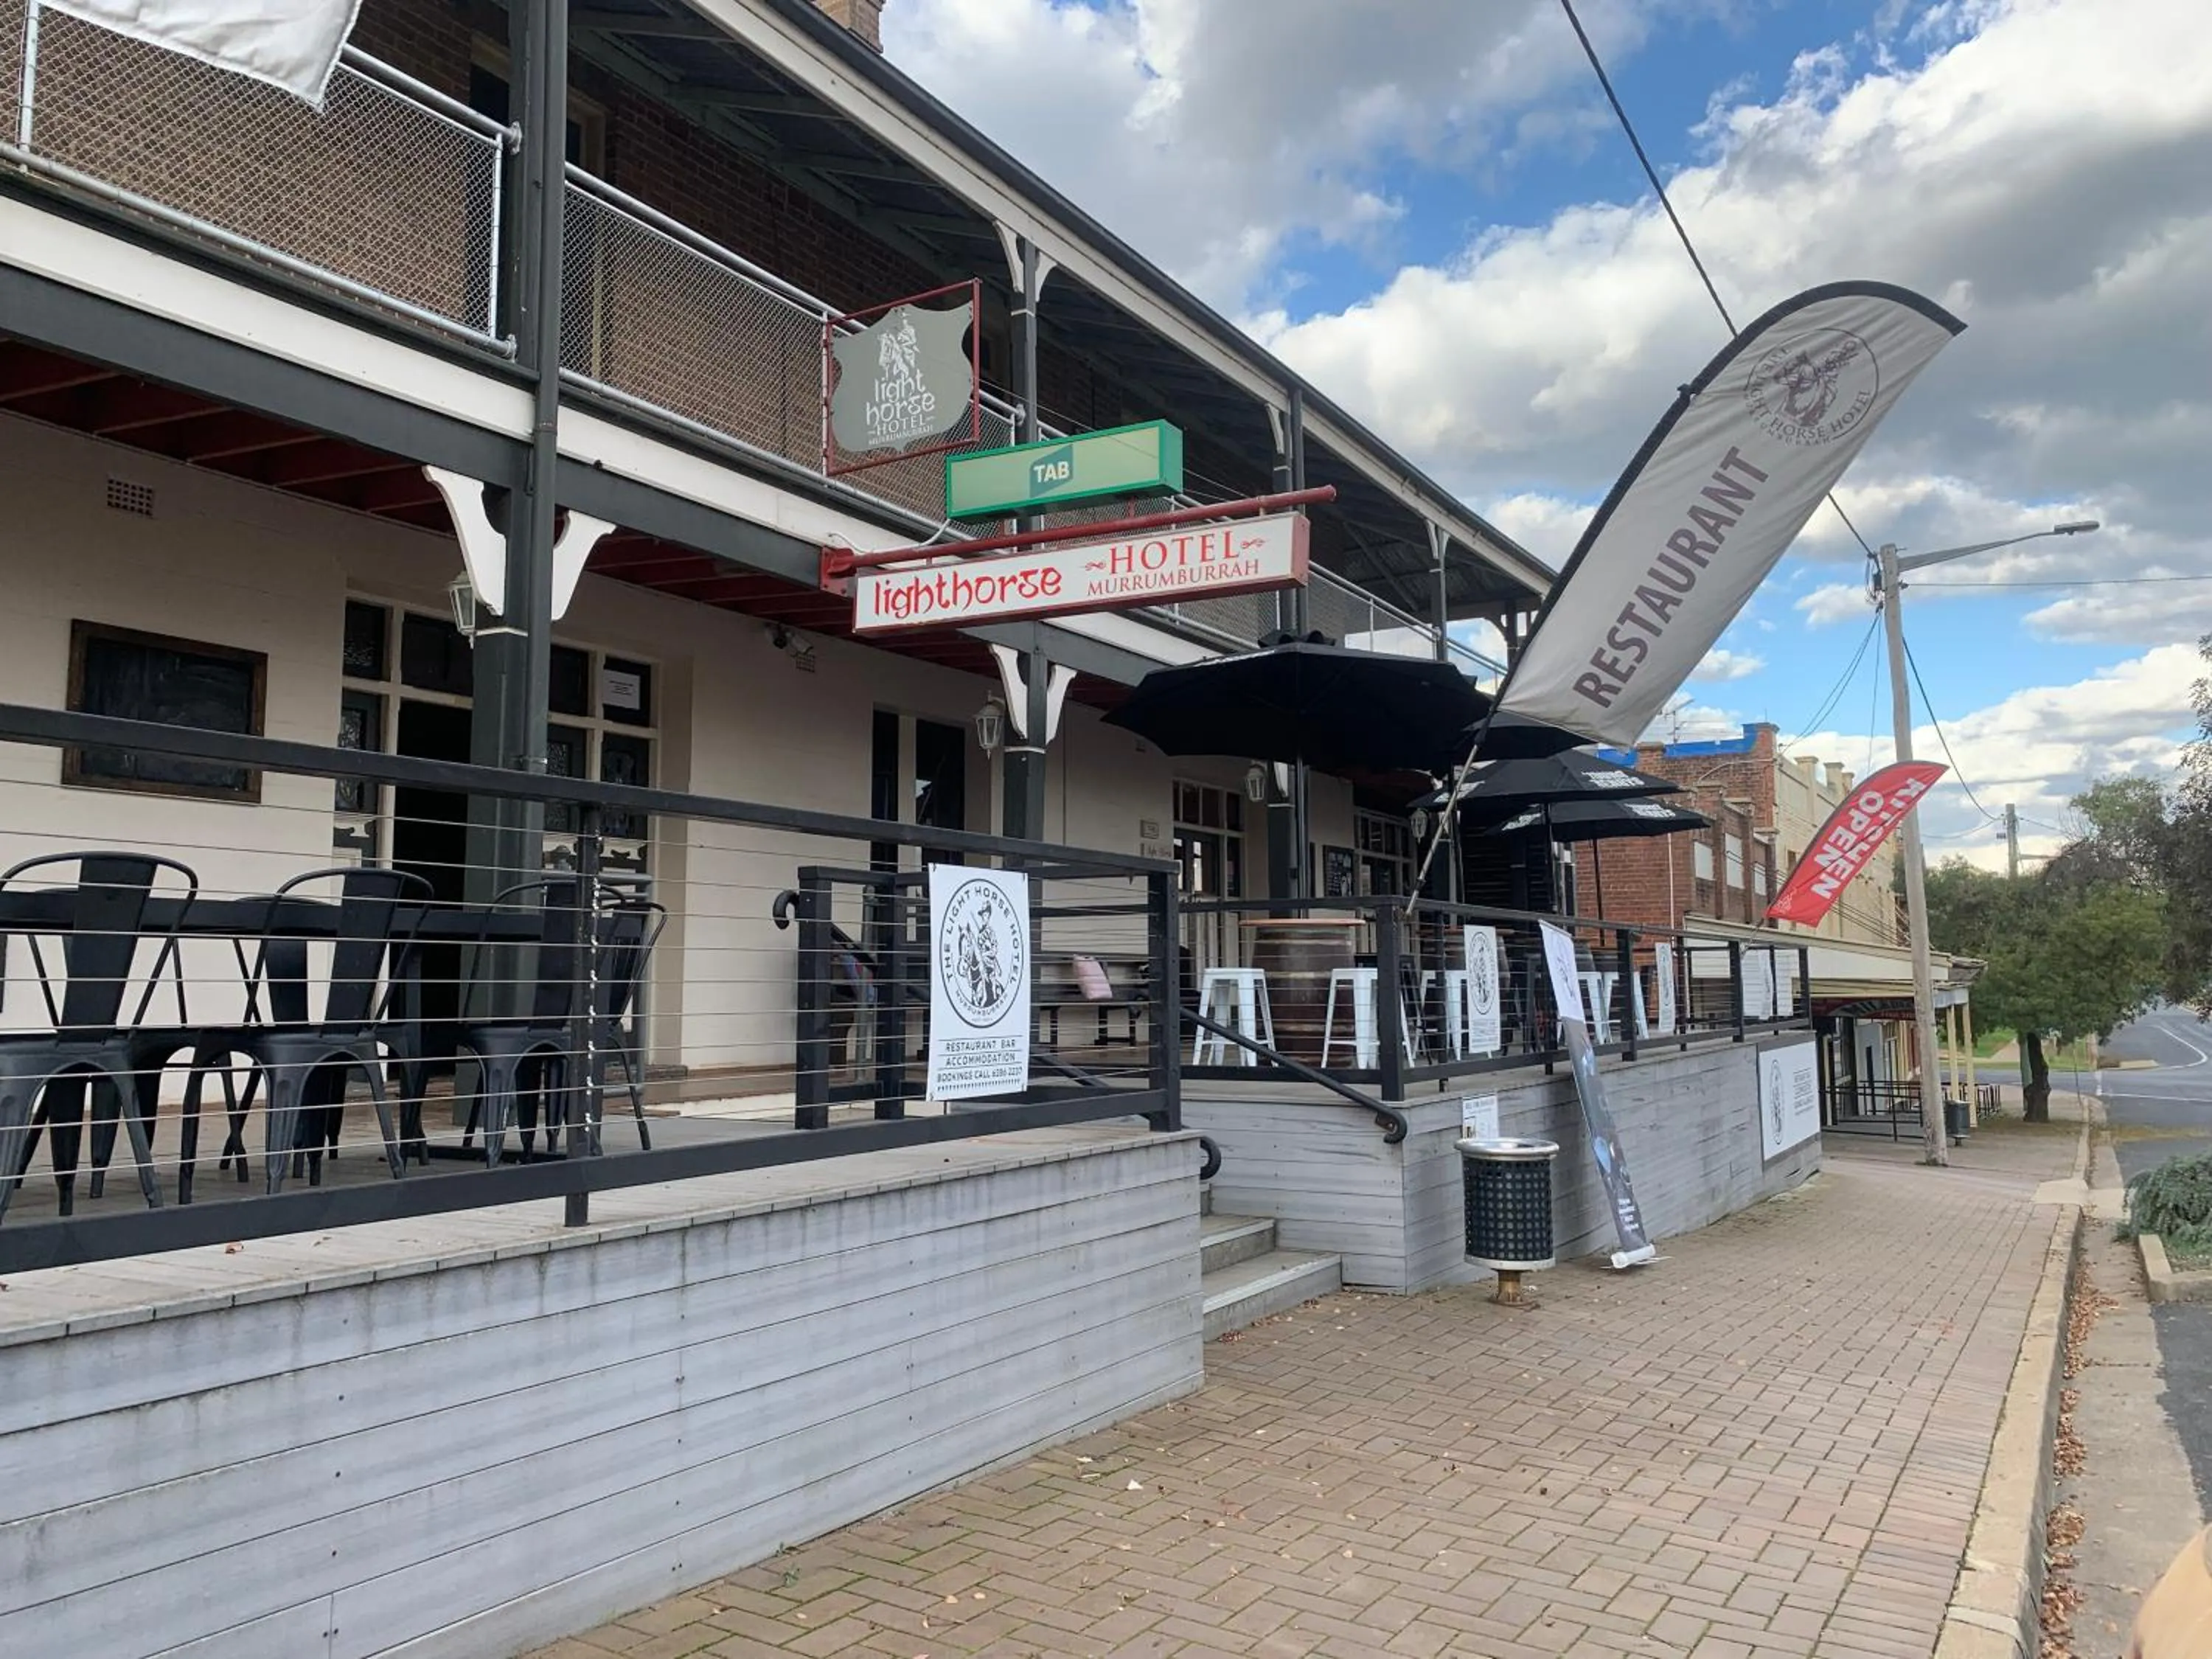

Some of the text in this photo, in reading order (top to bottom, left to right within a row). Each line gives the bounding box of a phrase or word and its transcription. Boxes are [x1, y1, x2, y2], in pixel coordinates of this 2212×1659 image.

[874, 368, 926, 403] light
[866, 391, 936, 426] horse
[876, 414, 927, 437] HOTEL
[1770, 417, 1826, 439] HORSE
[1830, 389, 1871, 432] HOTEL
[1033, 461, 1069, 483] TAB
[1110, 530, 1241, 574] HOTEL
[874, 566, 1063, 620] lighthorse
[1086, 559, 1259, 597] MURRUMBURRAH
[1573, 445, 1769, 709] RESTAURANT
[1811, 778, 1927, 900] KITCHEN
[1814, 790, 1885, 868] OPEN
[943, 886, 1020, 984] THE LIGHT HORSE HOTEL
[945, 1039, 1015, 1053] RESTAURANT BAR
[945, 1053, 1015, 1066] ACCOMMODATION
[937, 1071, 973, 1083] BOOKINGS
[974, 1069, 990, 1079] CALL
